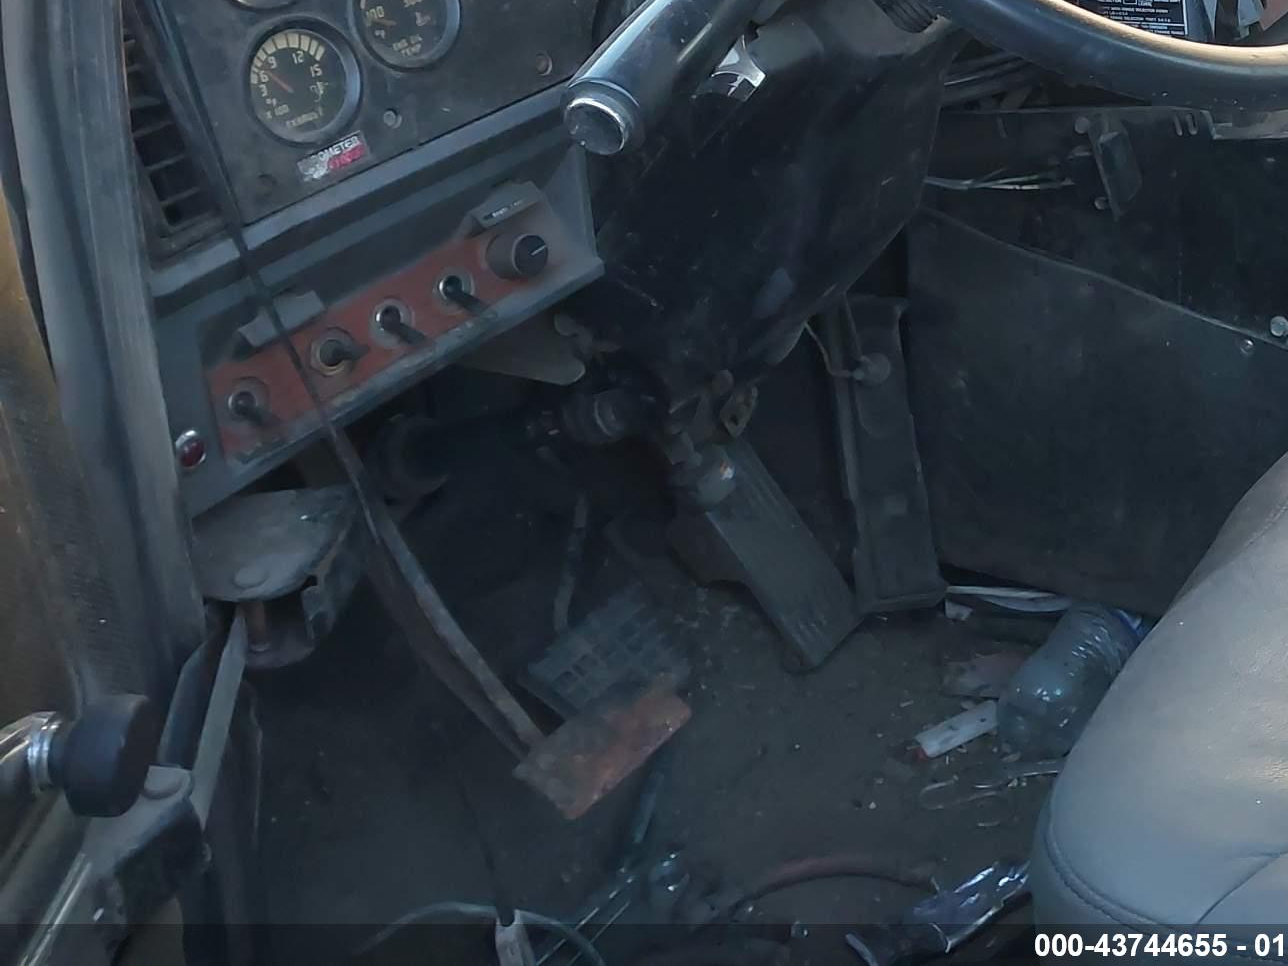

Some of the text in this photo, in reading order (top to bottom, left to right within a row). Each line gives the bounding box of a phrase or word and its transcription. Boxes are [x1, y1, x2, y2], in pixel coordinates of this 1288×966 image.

[268, 56, 277, 69] 9
[292, 51, 304, 64] 12
[260, 71, 269, 83] 6
[310, 64, 322, 77] 15
[259, 85, 267, 97] 3
